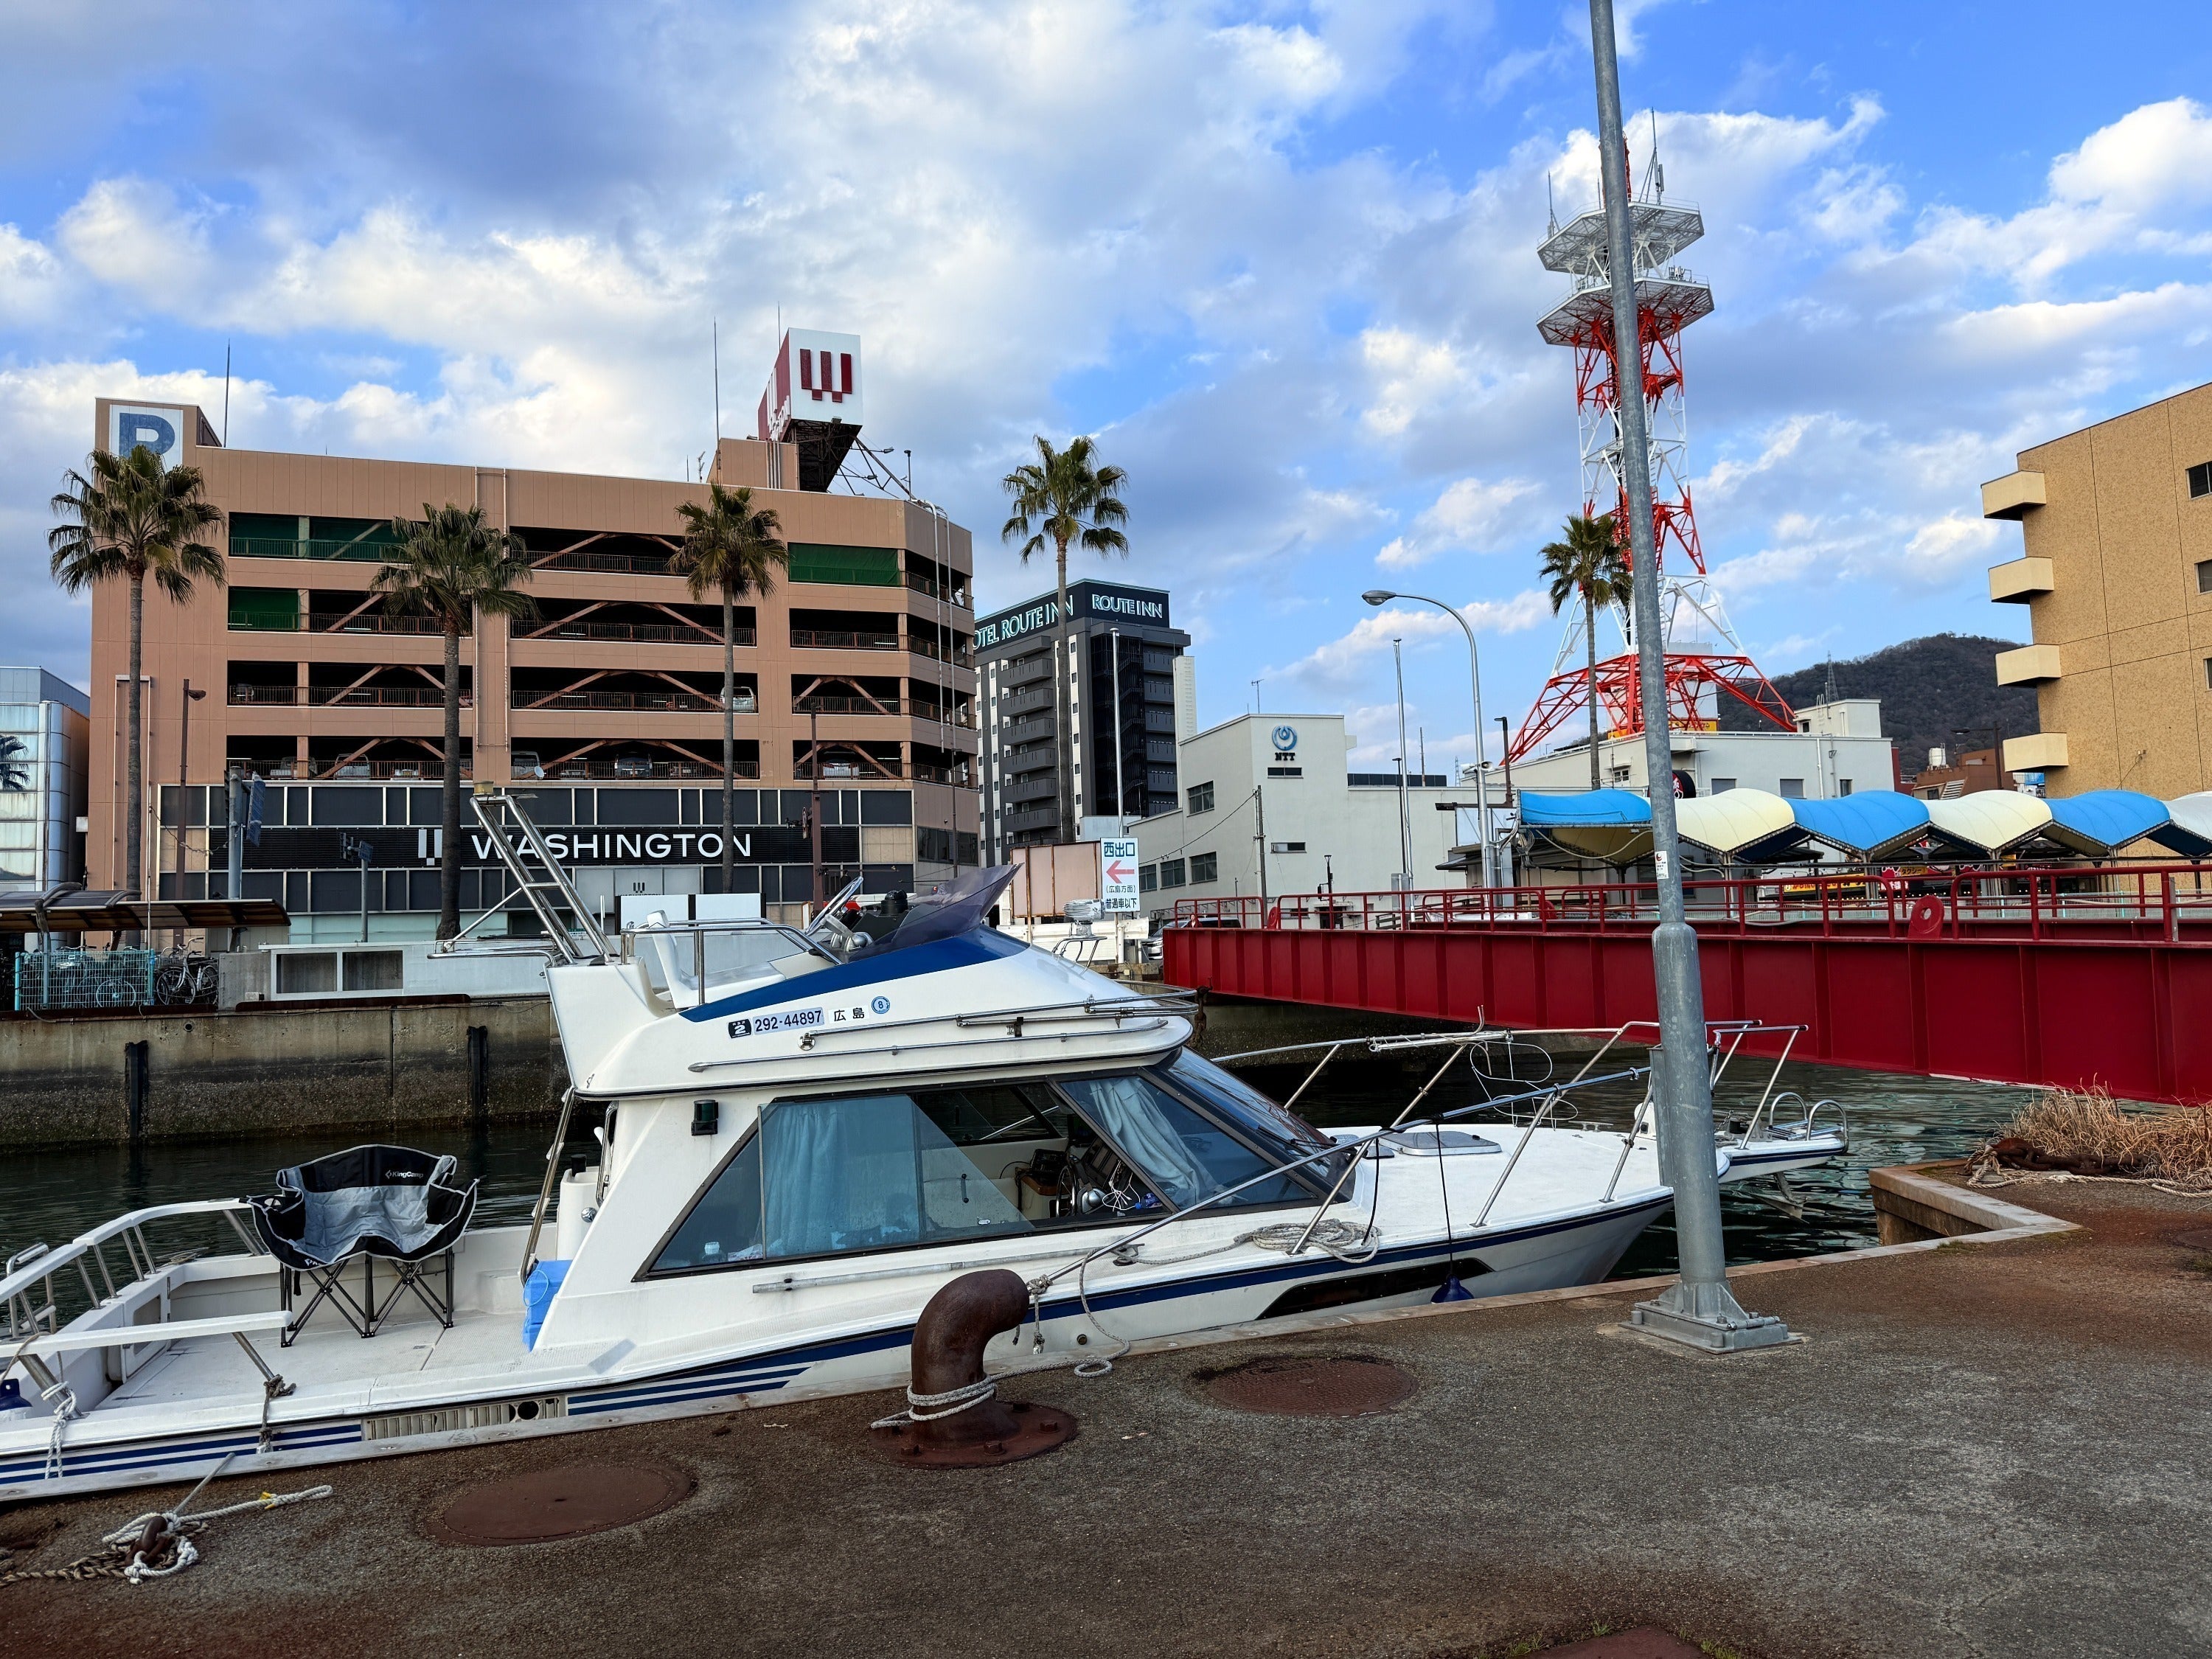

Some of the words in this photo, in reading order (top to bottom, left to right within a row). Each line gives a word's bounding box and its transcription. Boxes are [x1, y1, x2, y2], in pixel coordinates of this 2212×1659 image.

[119, 413, 175, 459] P
[1092, 594, 1135, 614] ROUTE
[1136, 600, 1163, 618] INN
[972, 624, 1000, 650] OTEL
[1001, 606, 1043, 640] ROUTE
[1274, 752, 1295, 761] NTT
[471, 833, 751, 860] WASHINGTON
[1103, 842, 1135, 858] 西出口
[1105, 897, 1137, 908] 普通車以下
[877, 1001, 884, 1009] 8
[754, 1010, 821, 1032] 292-44897
[834, 1007, 865, 1021] 広島
[392, 1171, 424, 1179] KingCamp
